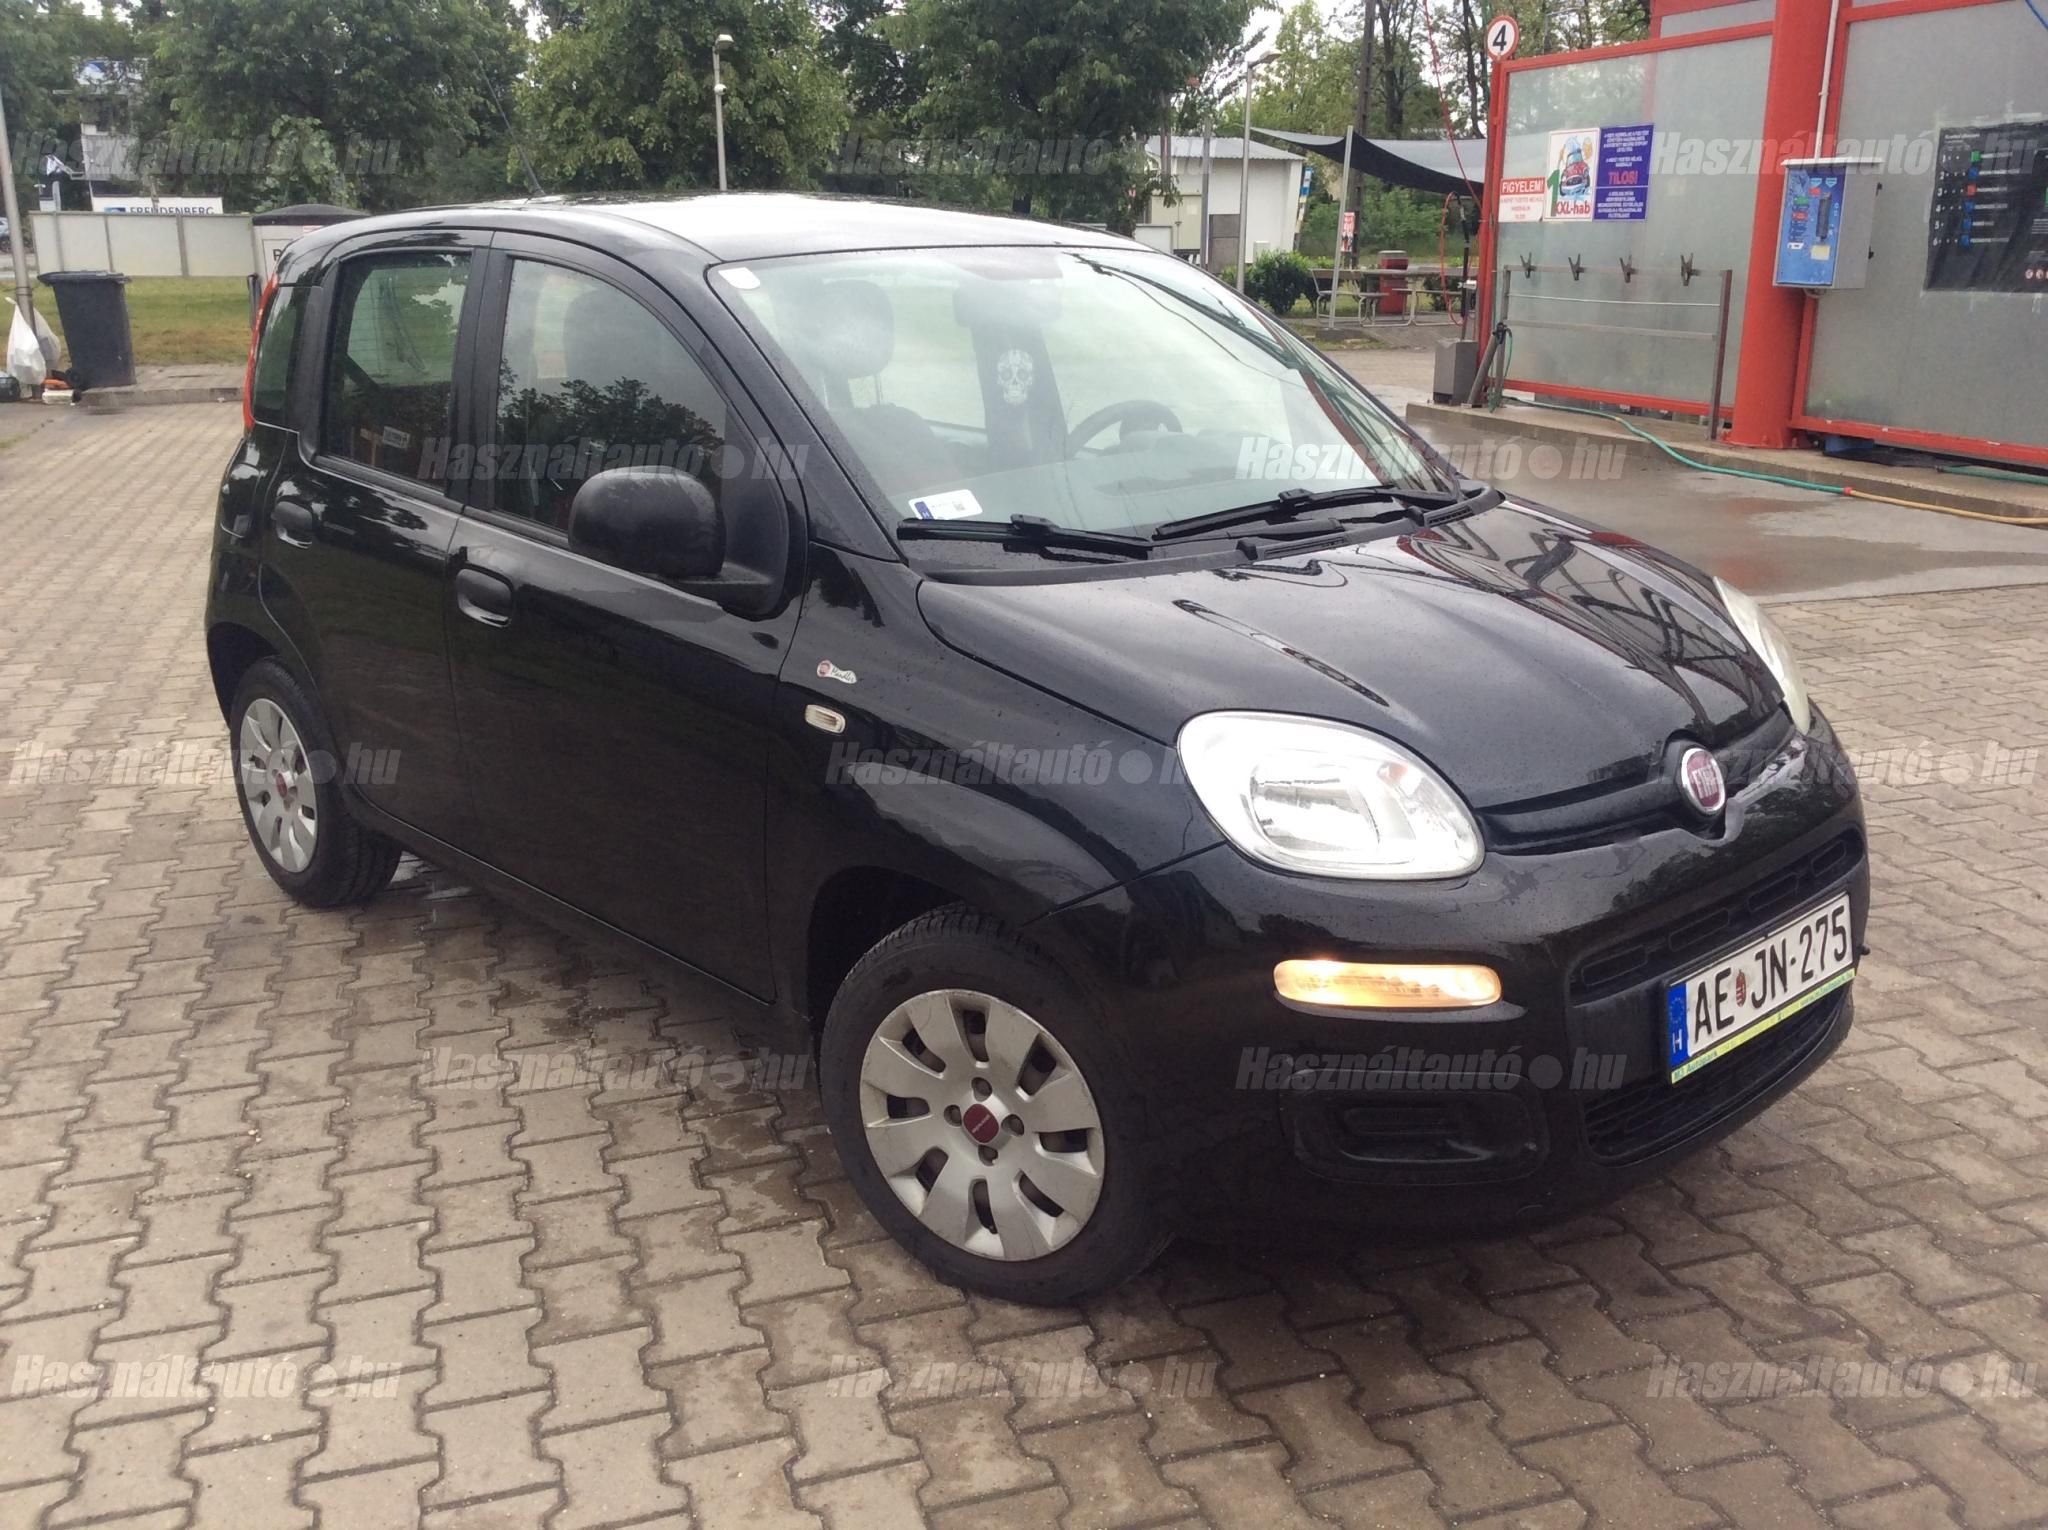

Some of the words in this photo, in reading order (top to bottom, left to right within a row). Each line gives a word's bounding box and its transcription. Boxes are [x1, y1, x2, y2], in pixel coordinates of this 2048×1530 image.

[1493, 24, 1507, 51] 4
[1695, 967, 1735, 1044] AE
[1672, 1029, 1682, 1053] H
